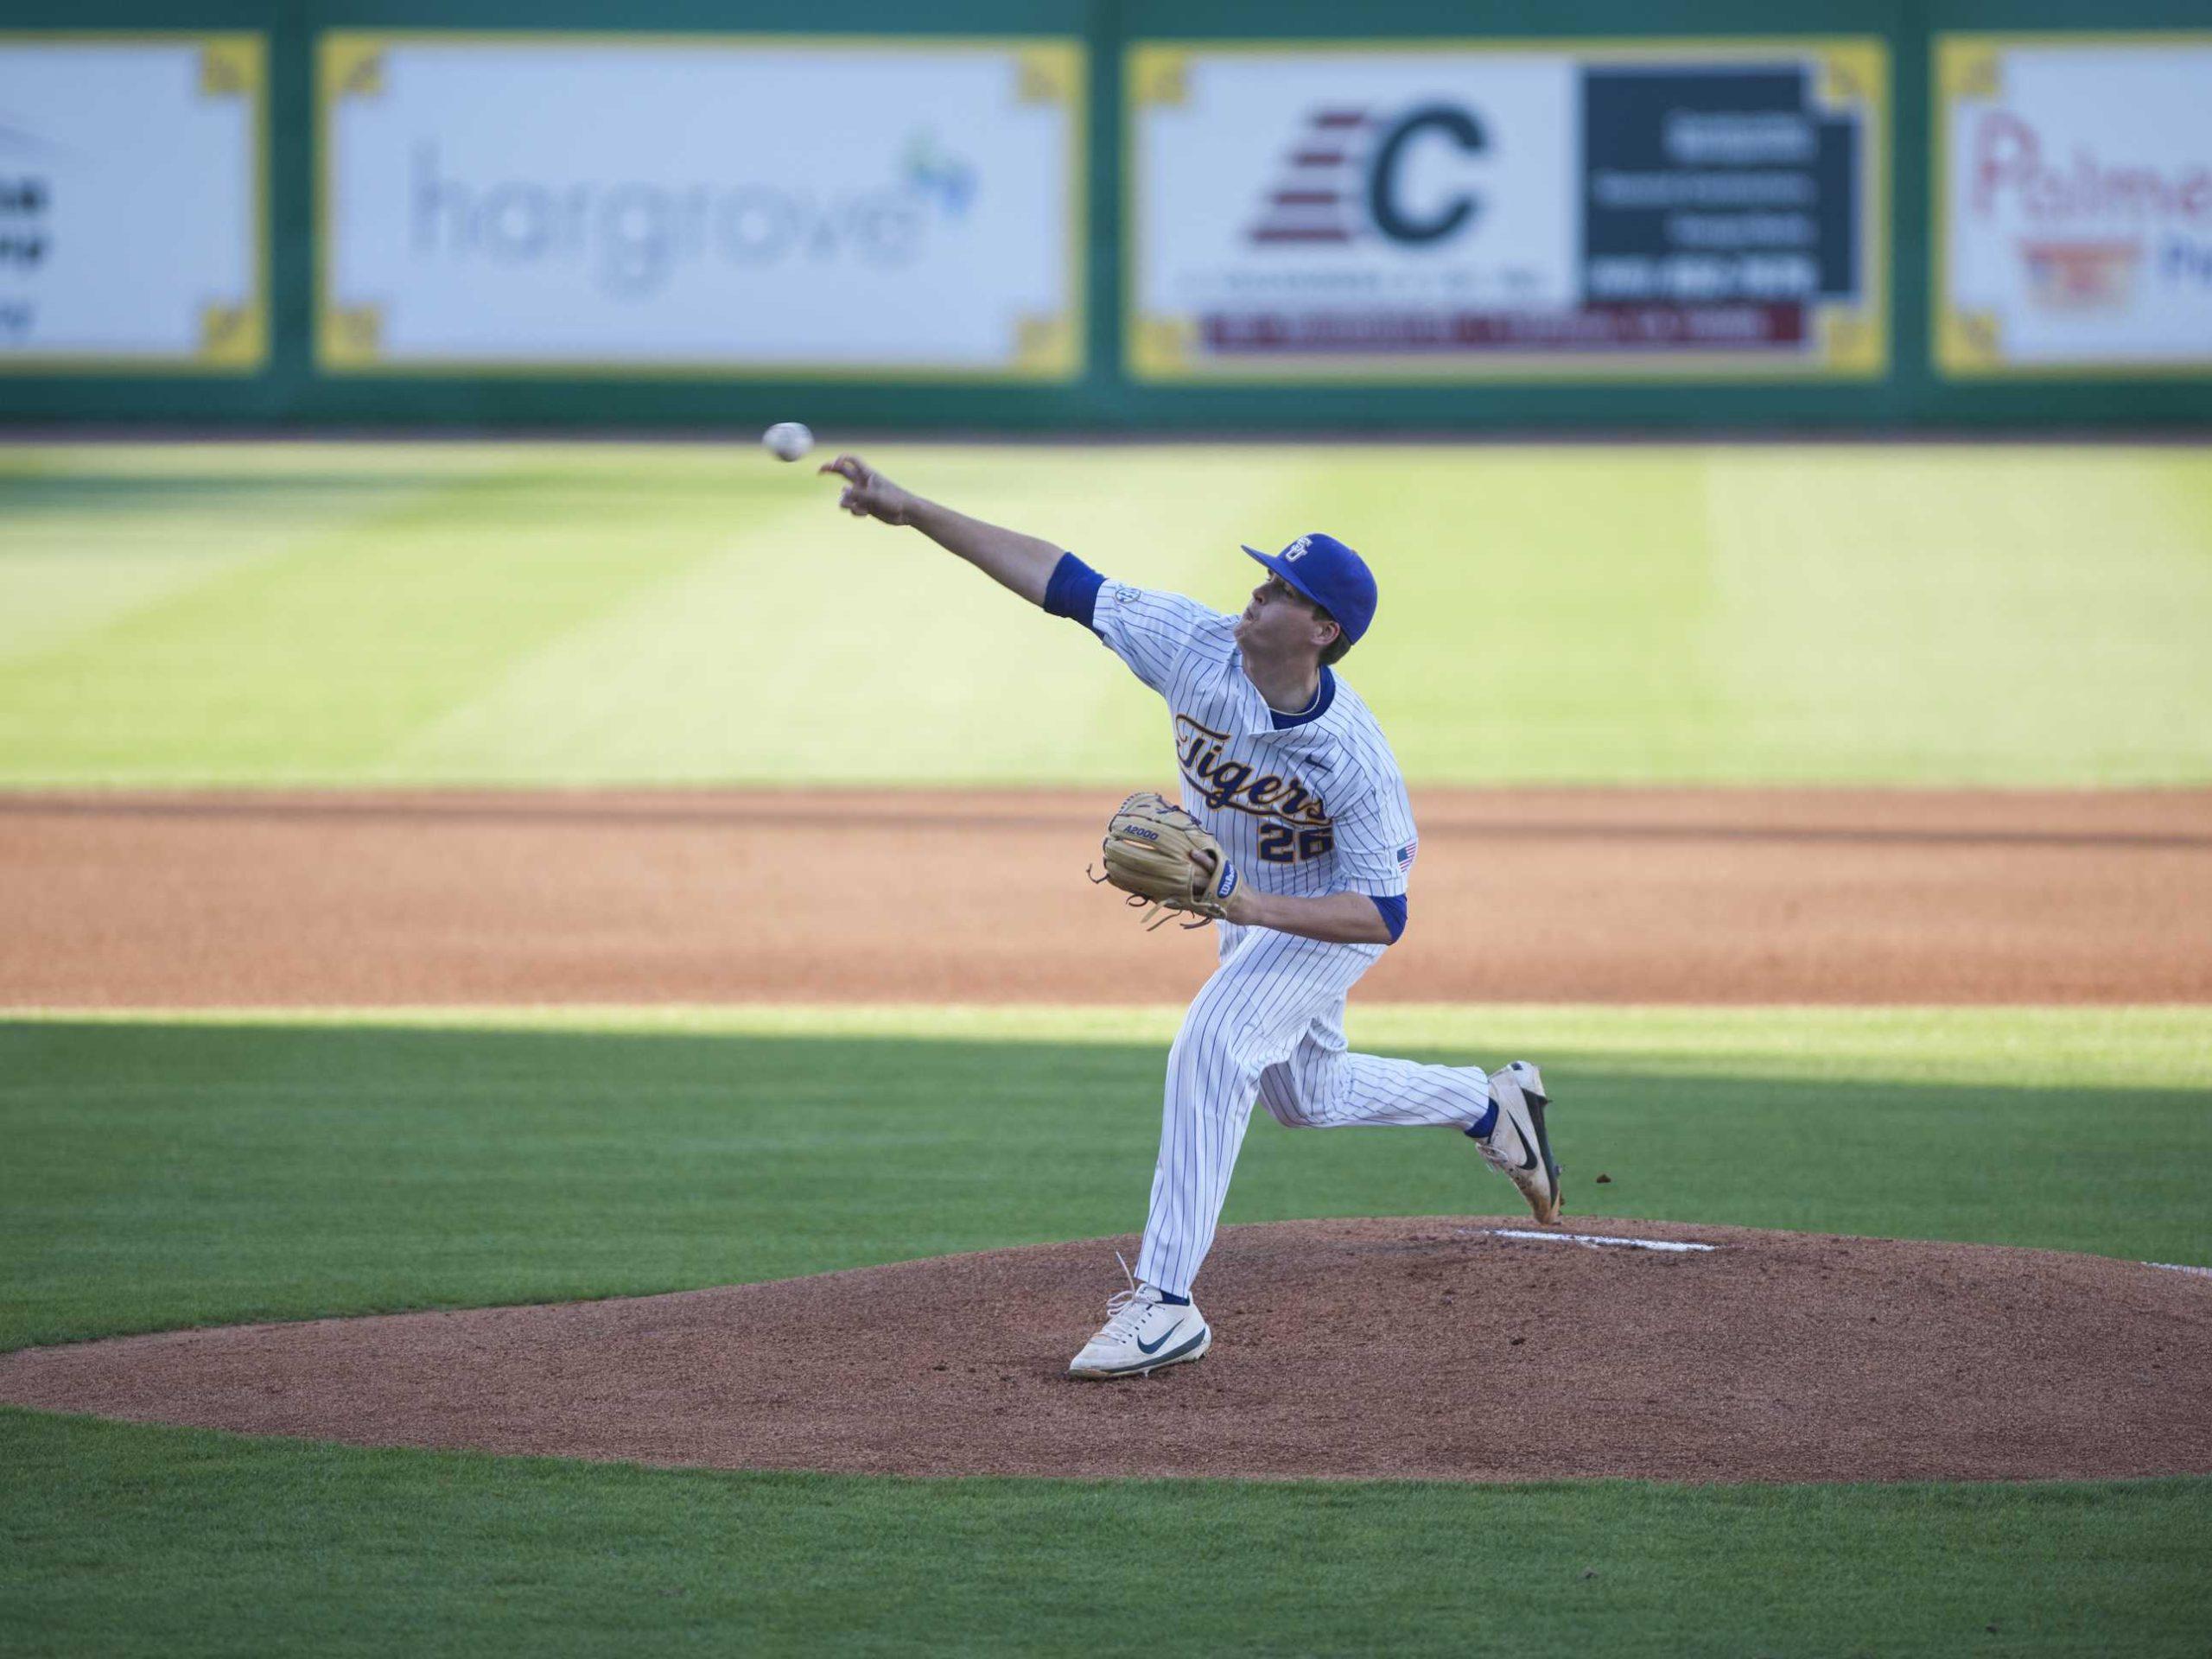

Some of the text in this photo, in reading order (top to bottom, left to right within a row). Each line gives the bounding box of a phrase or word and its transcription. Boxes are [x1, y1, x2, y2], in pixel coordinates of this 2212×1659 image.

[410, 138, 925, 302] hargrove
[1176, 714, 1333, 827] Tigers
[1123, 824, 1159, 842] A2000
[1258, 822, 1333, 863] 26
